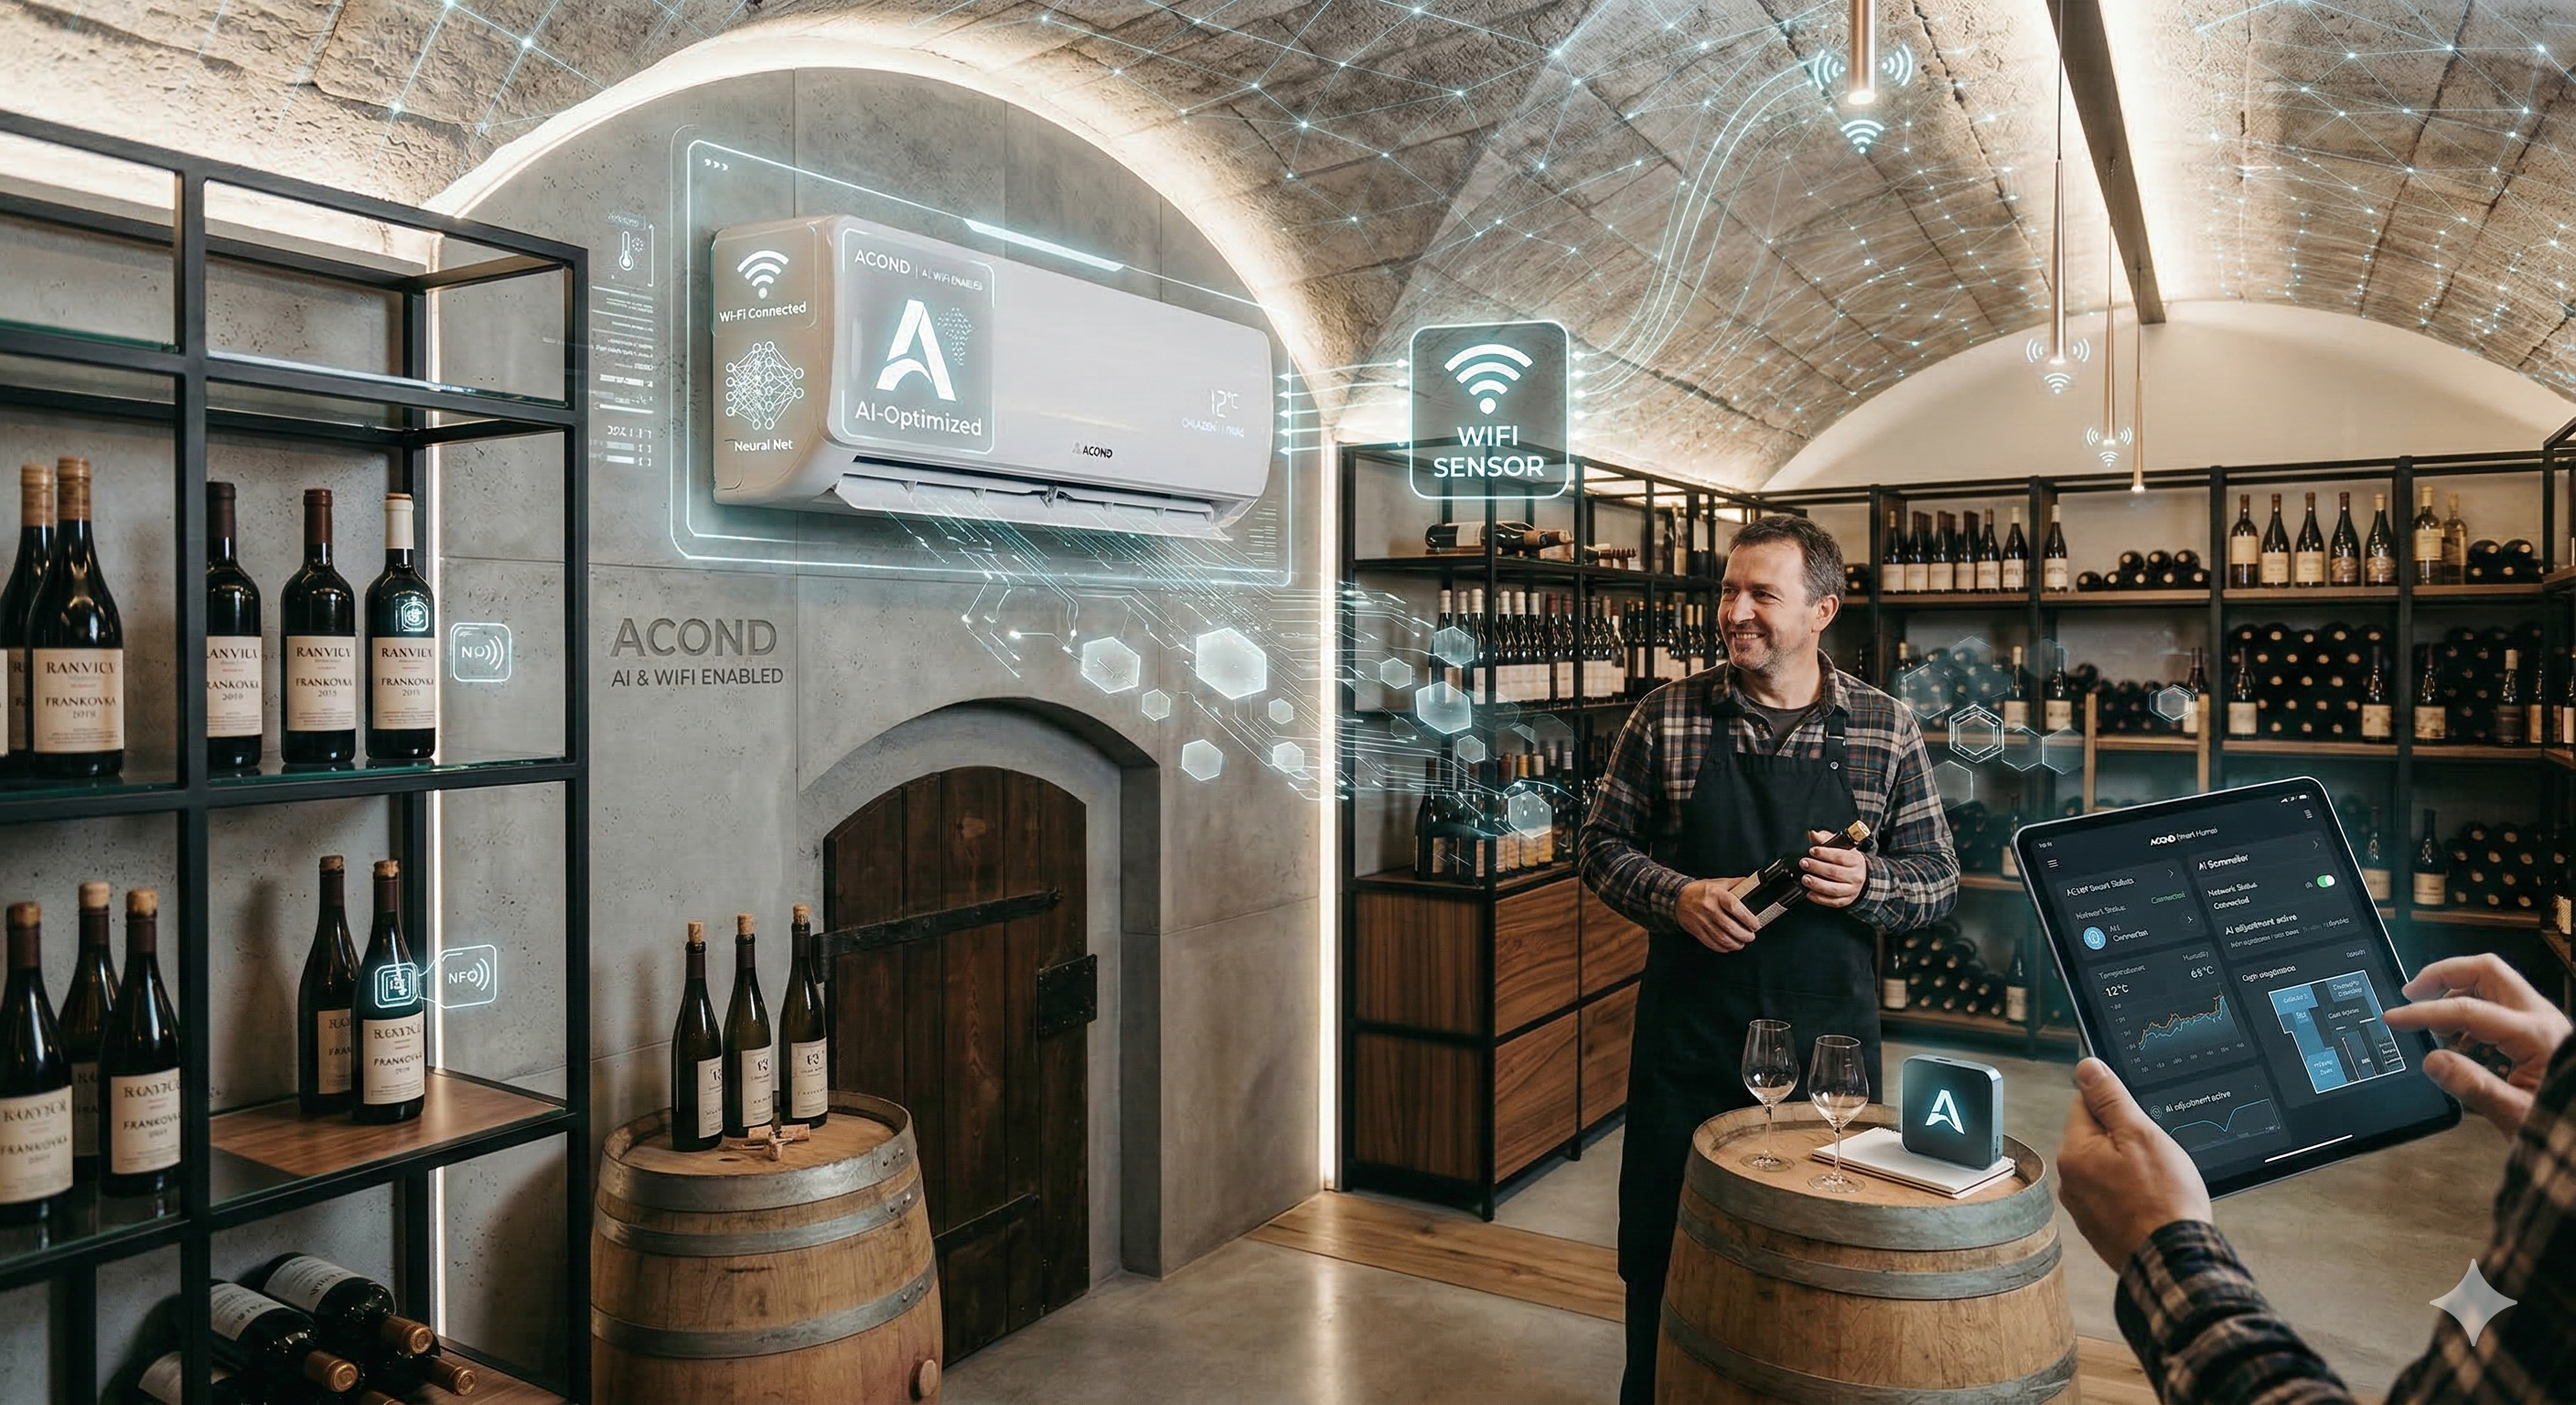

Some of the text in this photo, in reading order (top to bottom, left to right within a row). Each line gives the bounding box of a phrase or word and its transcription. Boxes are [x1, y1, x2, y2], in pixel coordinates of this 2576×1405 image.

[854, 249, 911, 274] ACOND
[748, 300, 807, 319] Connected
[855, 401, 982, 437] AI-Optimized
[735, 439, 794, 452] Neural Net
[1456, 425, 1519, 447] WIFI
[1433, 456, 1545, 478] SENSOR
[609, 617, 778, 658] ACOND
[611, 668, 783, 687] AI & WIFI ENABLED
